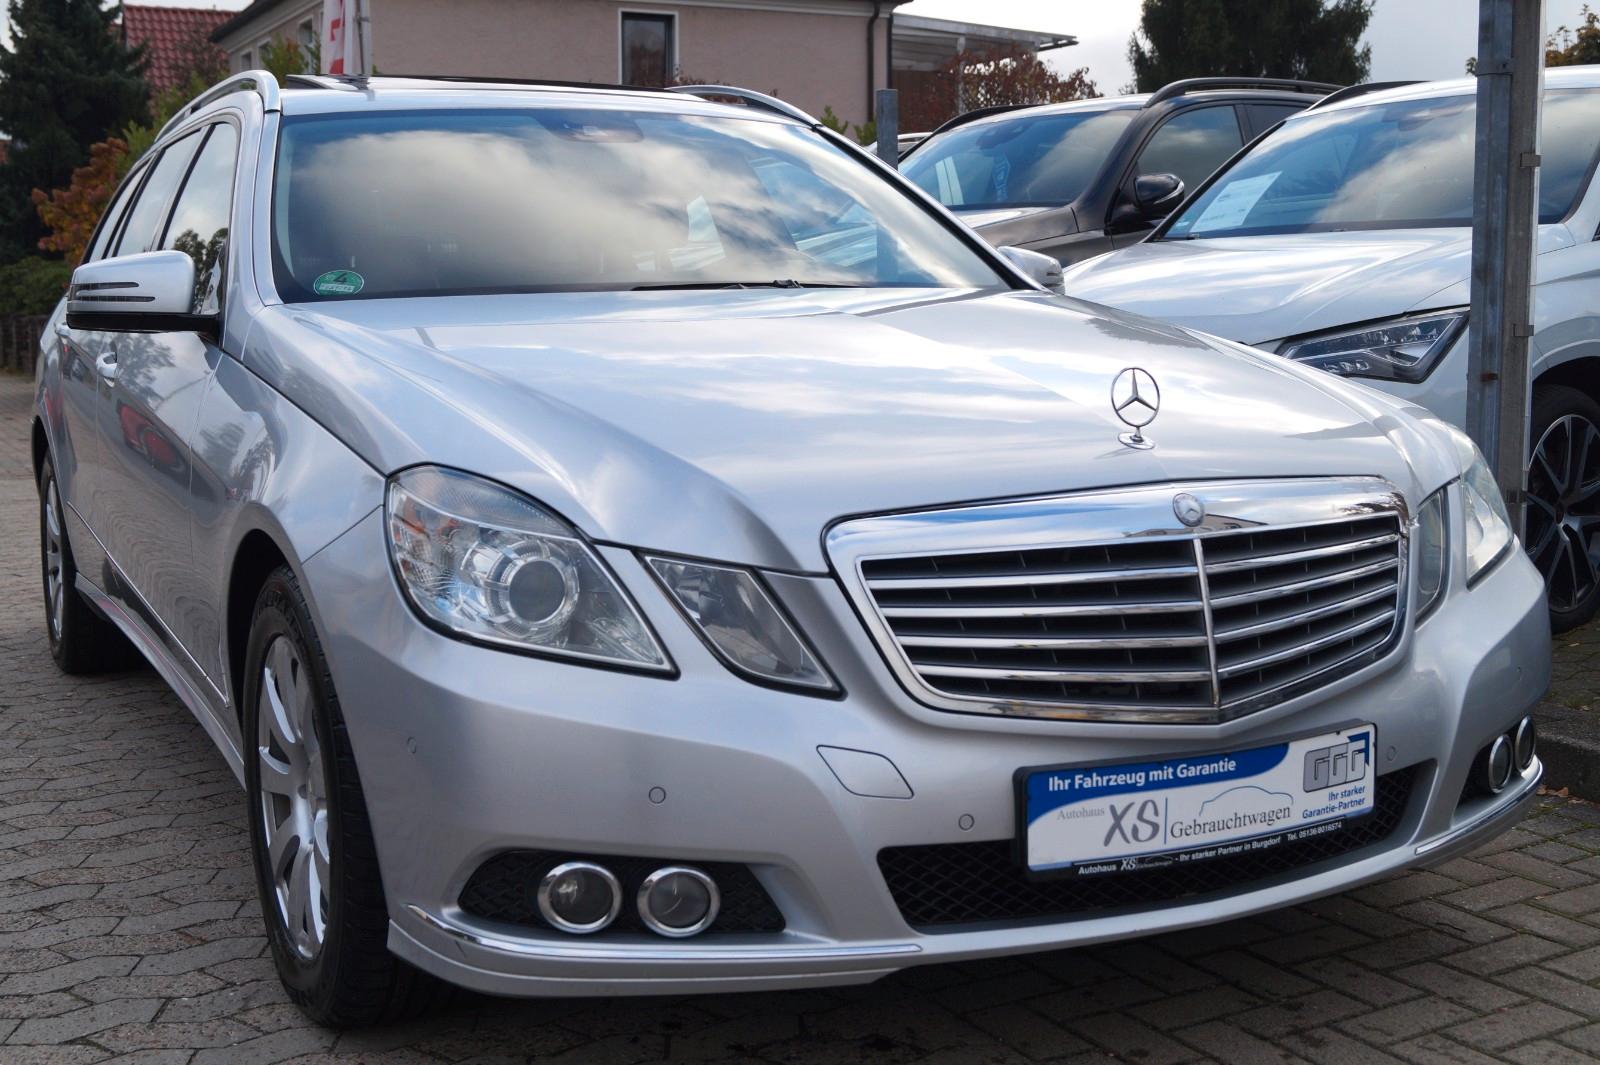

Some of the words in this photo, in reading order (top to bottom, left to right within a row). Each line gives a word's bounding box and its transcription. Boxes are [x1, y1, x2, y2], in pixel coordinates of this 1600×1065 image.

[333, 272, 348, 284] 4
[1049, 776, 1071, 791] Ihr
[1074, 770, 1146, 789] Fahrzeug
[1148, 766, 1173, 781] mit
[1176, 757, 1236, 778] Garantie
[1328, 791, 1340, 801] Ihr
[1340, 785, 1366, 798] starker
[1302, 797, 1366, 819] Garantie-Partner
[1057, 806, 1105, 820] Autohaus
[1103, 799, 1160, 847] XS
[1171, 806, 1291, 839] Gebrauchtwagen
[1078, 863, 1117, 875] Autohaus
[1120, 857, 1137, 871] XS
[1180, 853, 1190, 862] Ihr
[1191, 849, 1217, 860] starker
[1217, 844, 1243, 856] Partner
[1243, 842, 1251, 851] in
[1252, 836, 1281, 849] Burgdorf
